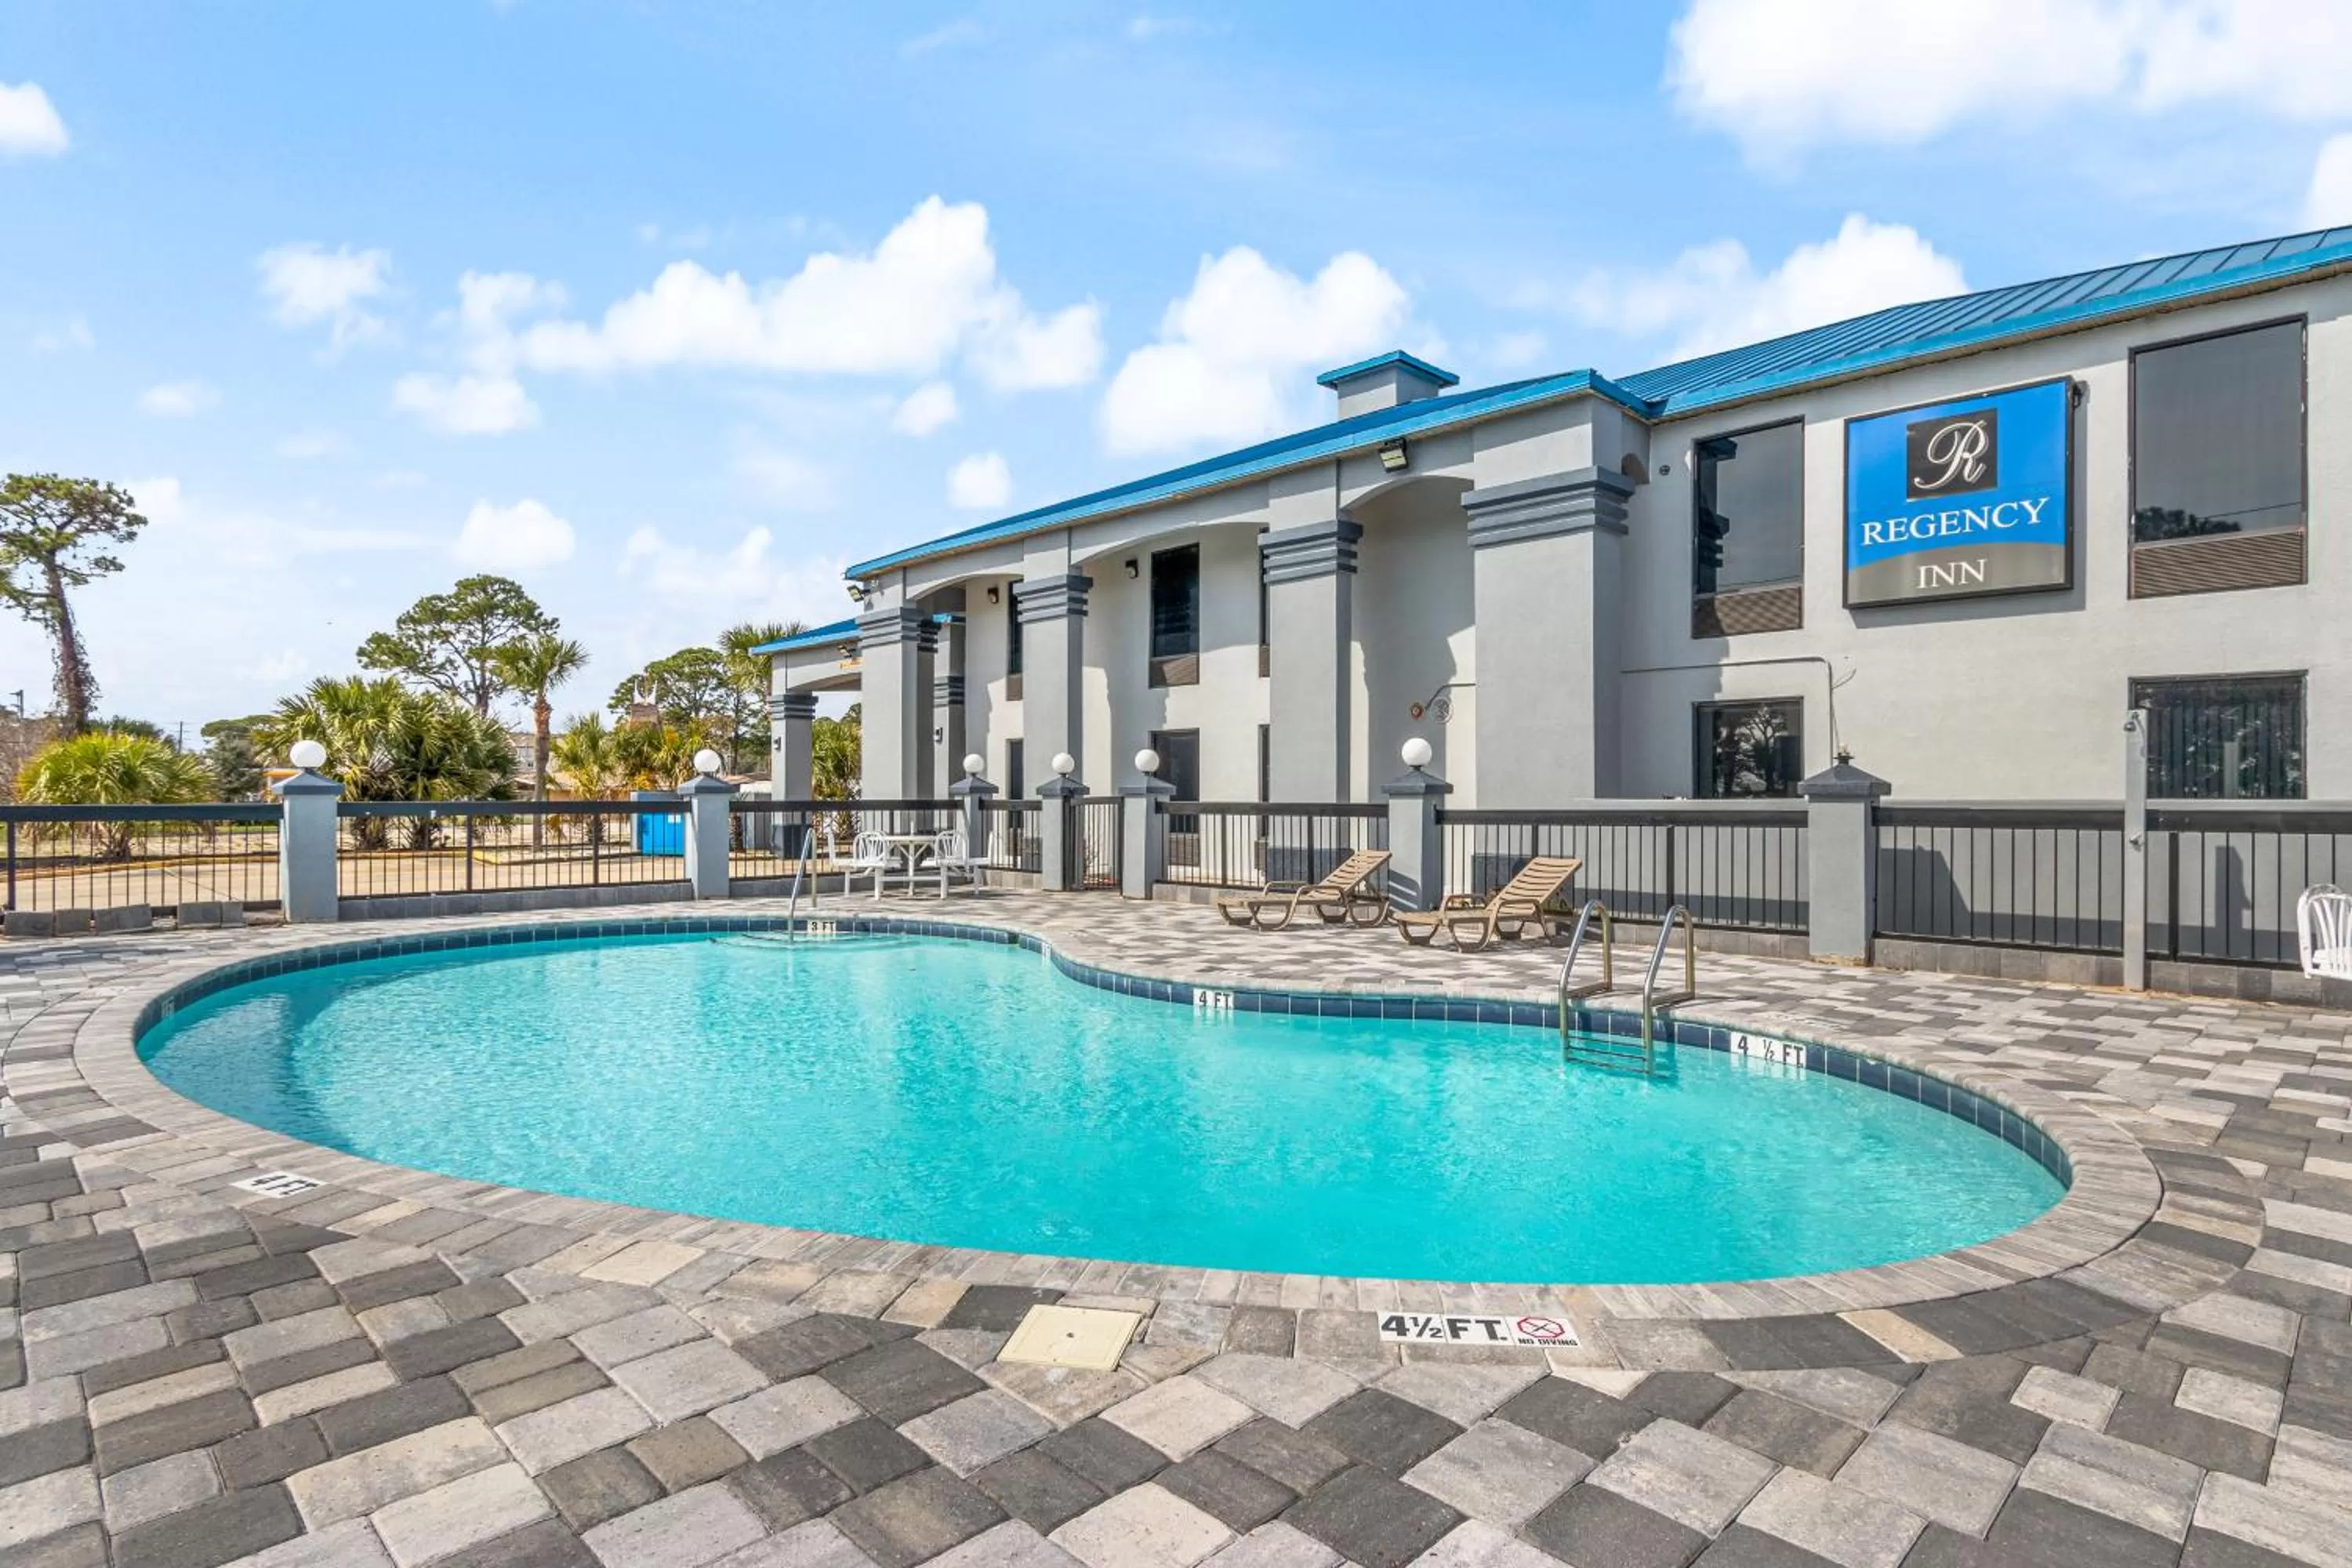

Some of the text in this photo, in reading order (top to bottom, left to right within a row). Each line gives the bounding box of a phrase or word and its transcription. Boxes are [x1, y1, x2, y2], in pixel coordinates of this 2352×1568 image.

[1913, 419, 1989, 489] R
[1861, 497, 2050, 546] REGENCY
[1917, 558, 1988, 589] INN
[811, 921, 818, 931] 3
[1199, 990, 1207, 1007] 4
[1738, 1035, 1749, 1055] 4
[251, 1175, 288, 1186] 4
